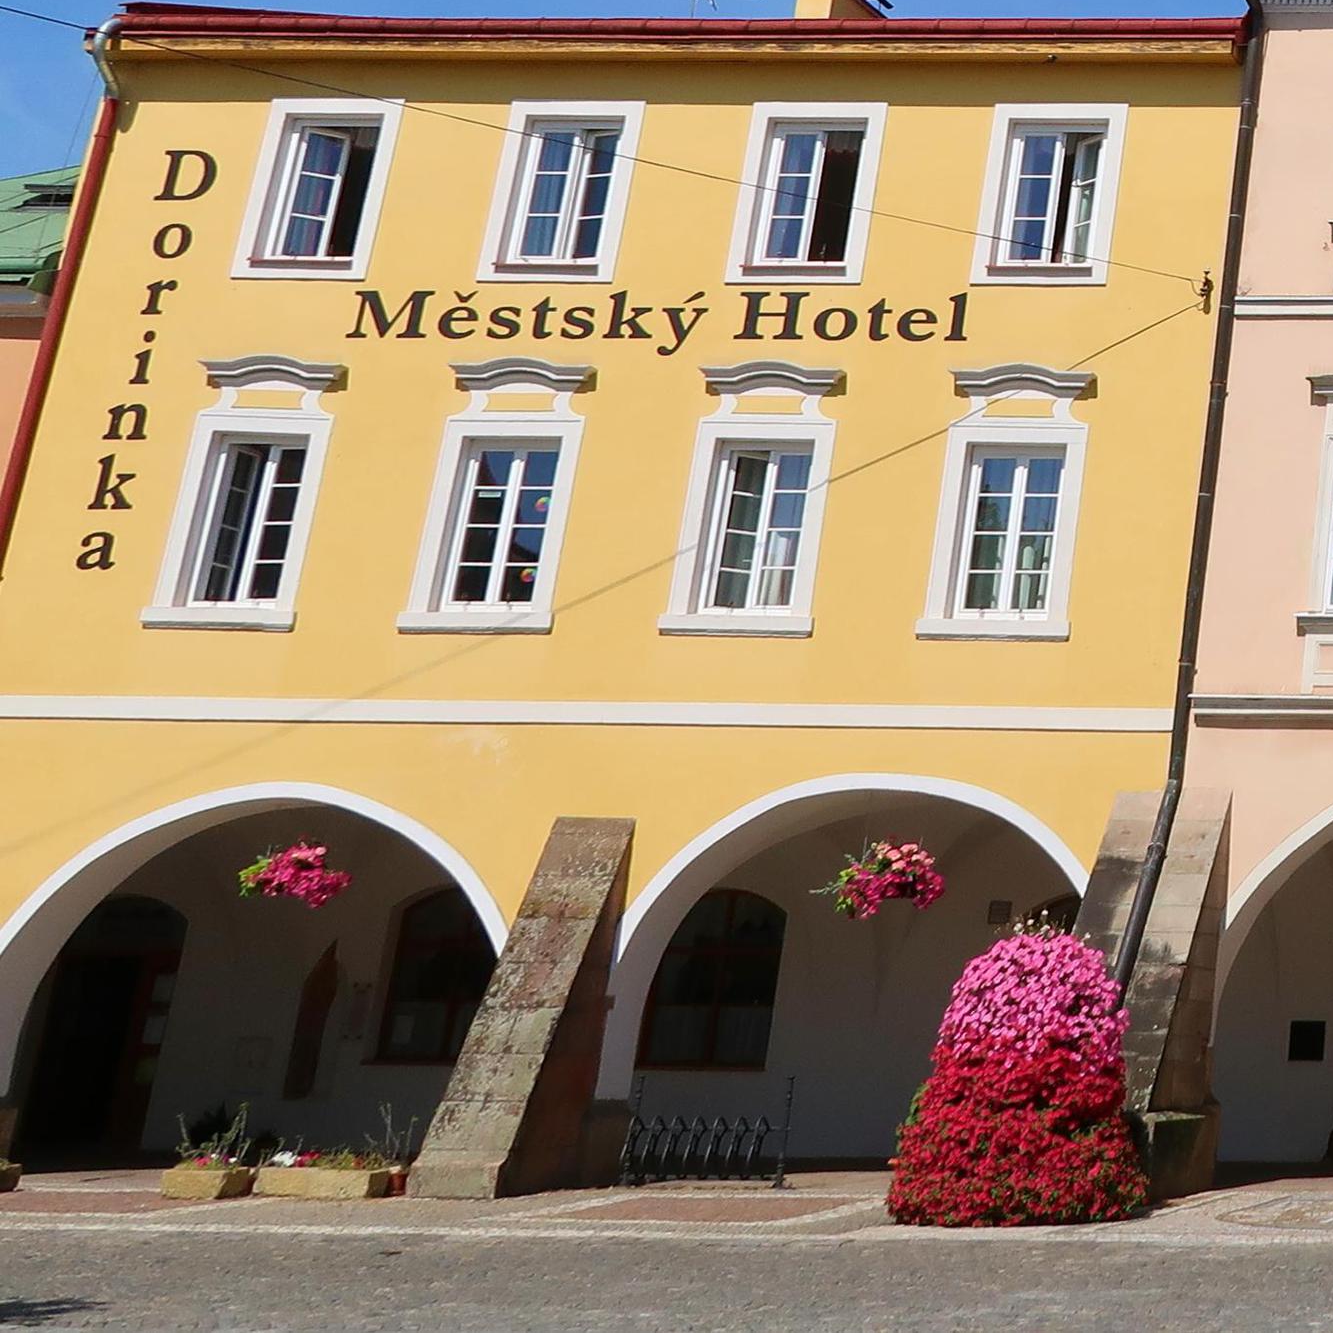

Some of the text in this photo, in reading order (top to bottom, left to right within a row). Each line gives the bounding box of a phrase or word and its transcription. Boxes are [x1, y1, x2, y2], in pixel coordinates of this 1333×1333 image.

[77, 150, 217, 570] Dorinka
[346, 289, 969, 356] Městský Hotel
